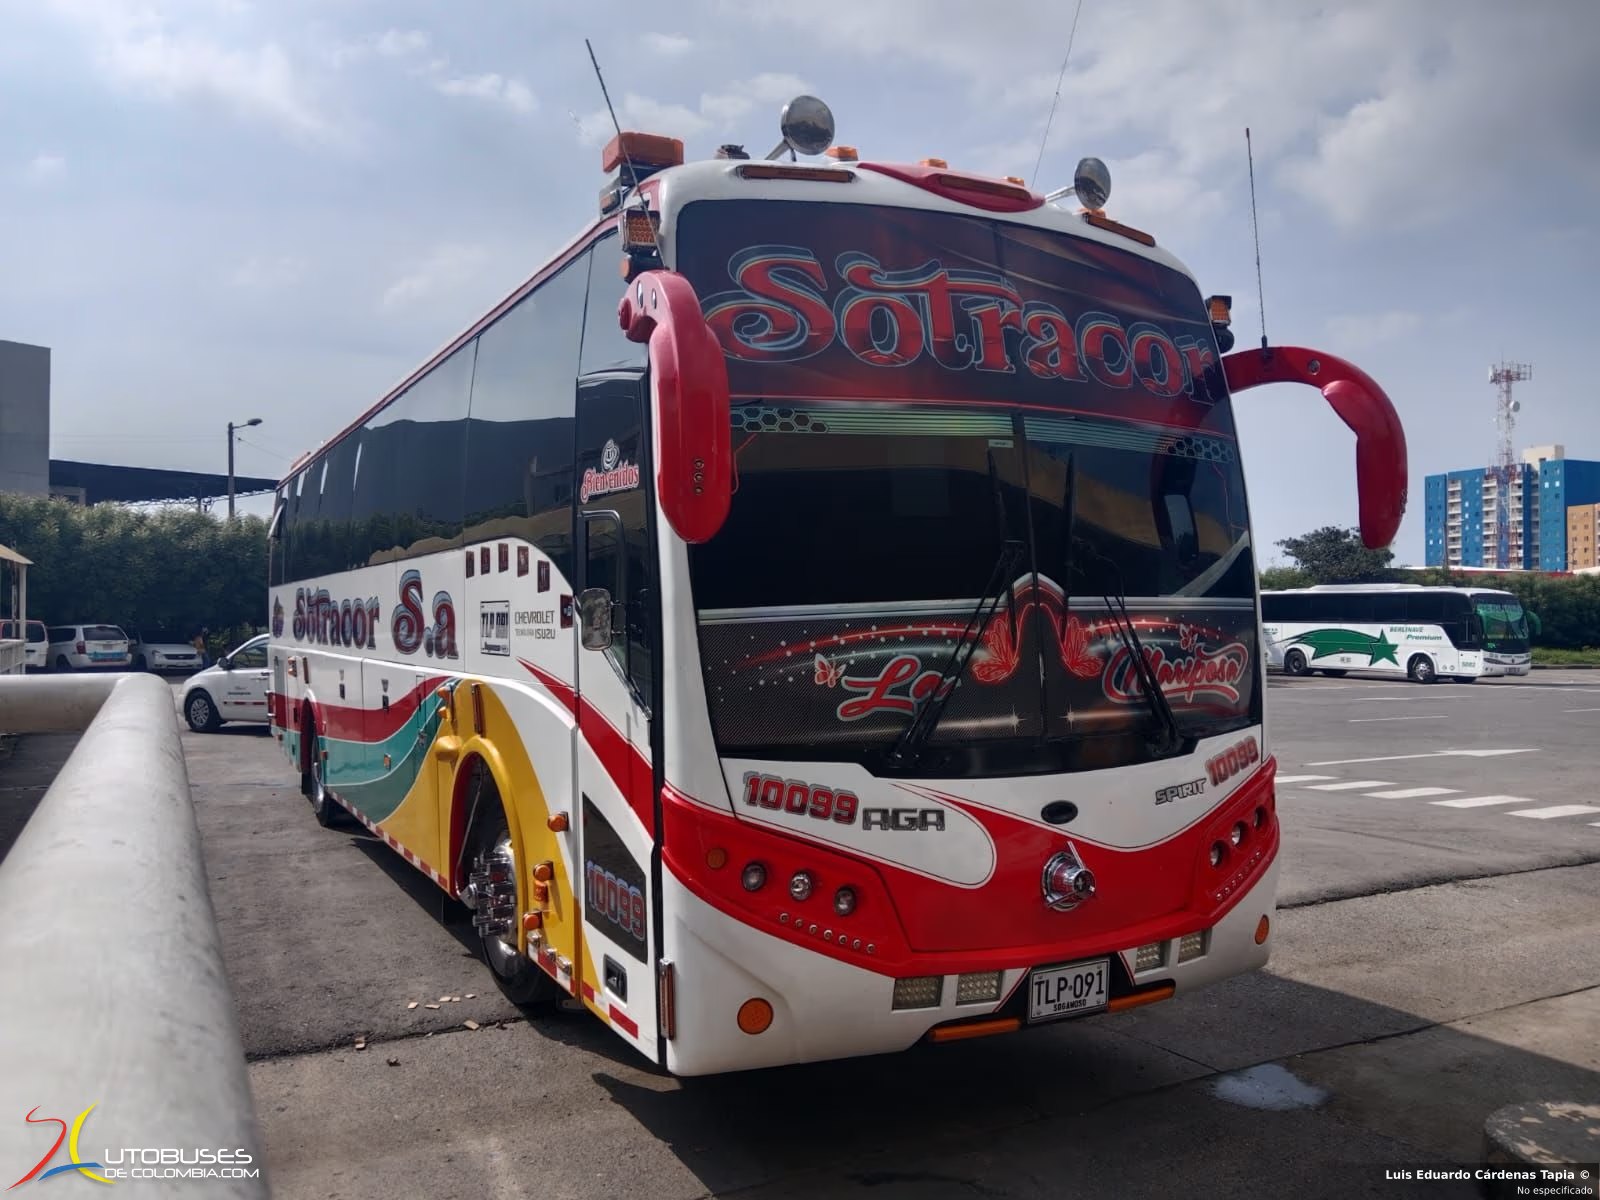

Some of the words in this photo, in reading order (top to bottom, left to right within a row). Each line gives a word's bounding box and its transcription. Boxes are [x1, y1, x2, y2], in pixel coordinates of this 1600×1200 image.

[702, 245, 1222, 403] Sotracor
[581, 459, 640, 505] Bienvenidos
[293, 587, 379, 650] Sotracor
[514, 610, 555, 625] CHEVROLET
[535, 628, 556, 640] ISUZU
[837, 655, 961, 721] La
[1102, 642, 1248, 704] Mariposa
[743, 771, 859, 825] 10099
[863, 807, 946, 832] AGA
[1155, 777, 1207, 805] SPIRIT
[586, 860, 646, 941] 10099
